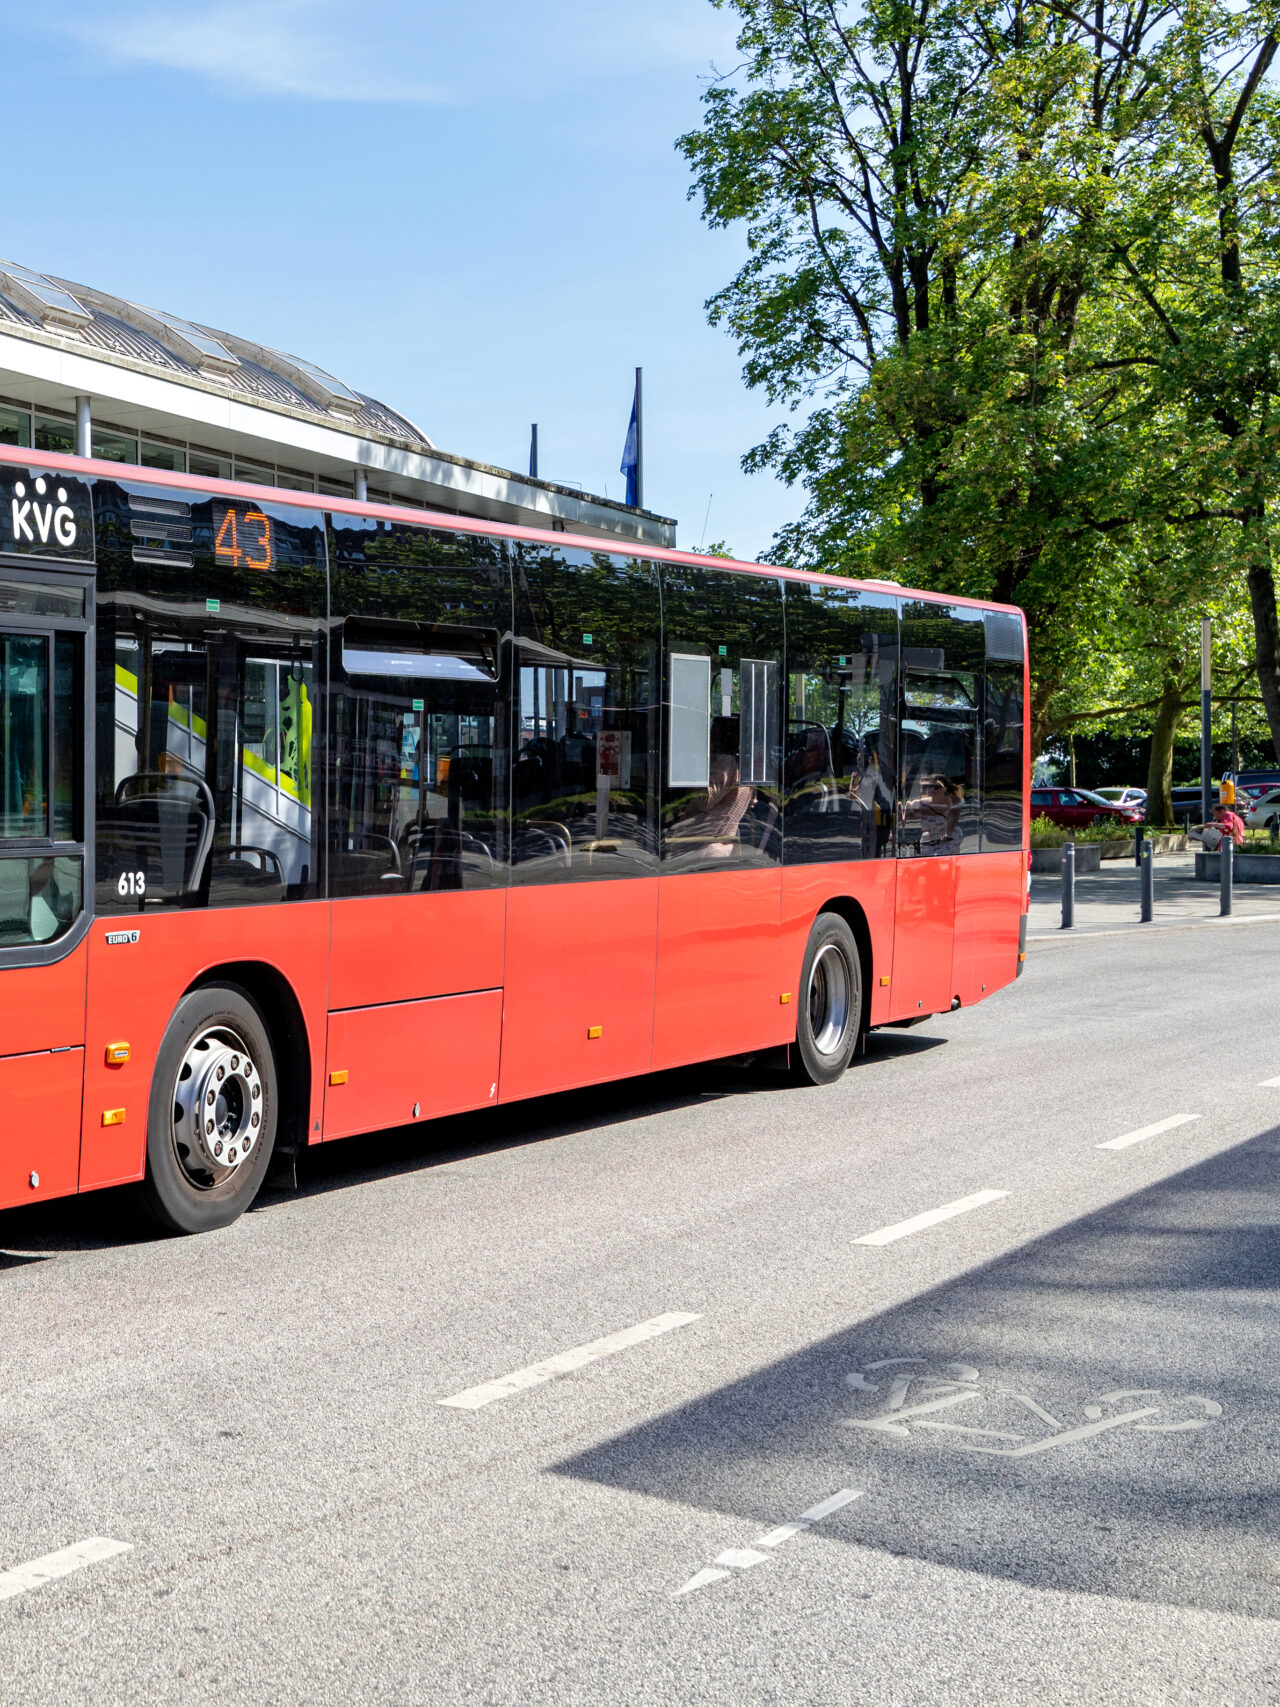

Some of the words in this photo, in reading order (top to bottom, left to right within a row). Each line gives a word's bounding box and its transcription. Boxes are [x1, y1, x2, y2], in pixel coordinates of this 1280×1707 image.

[12, 497, 77, 546] KVG
[215, 509, 271, 570] 43
[118, 871, 146, 896] 613
[108, 935, 128, 944] EURO
[131, 932, 138, 942] 6
